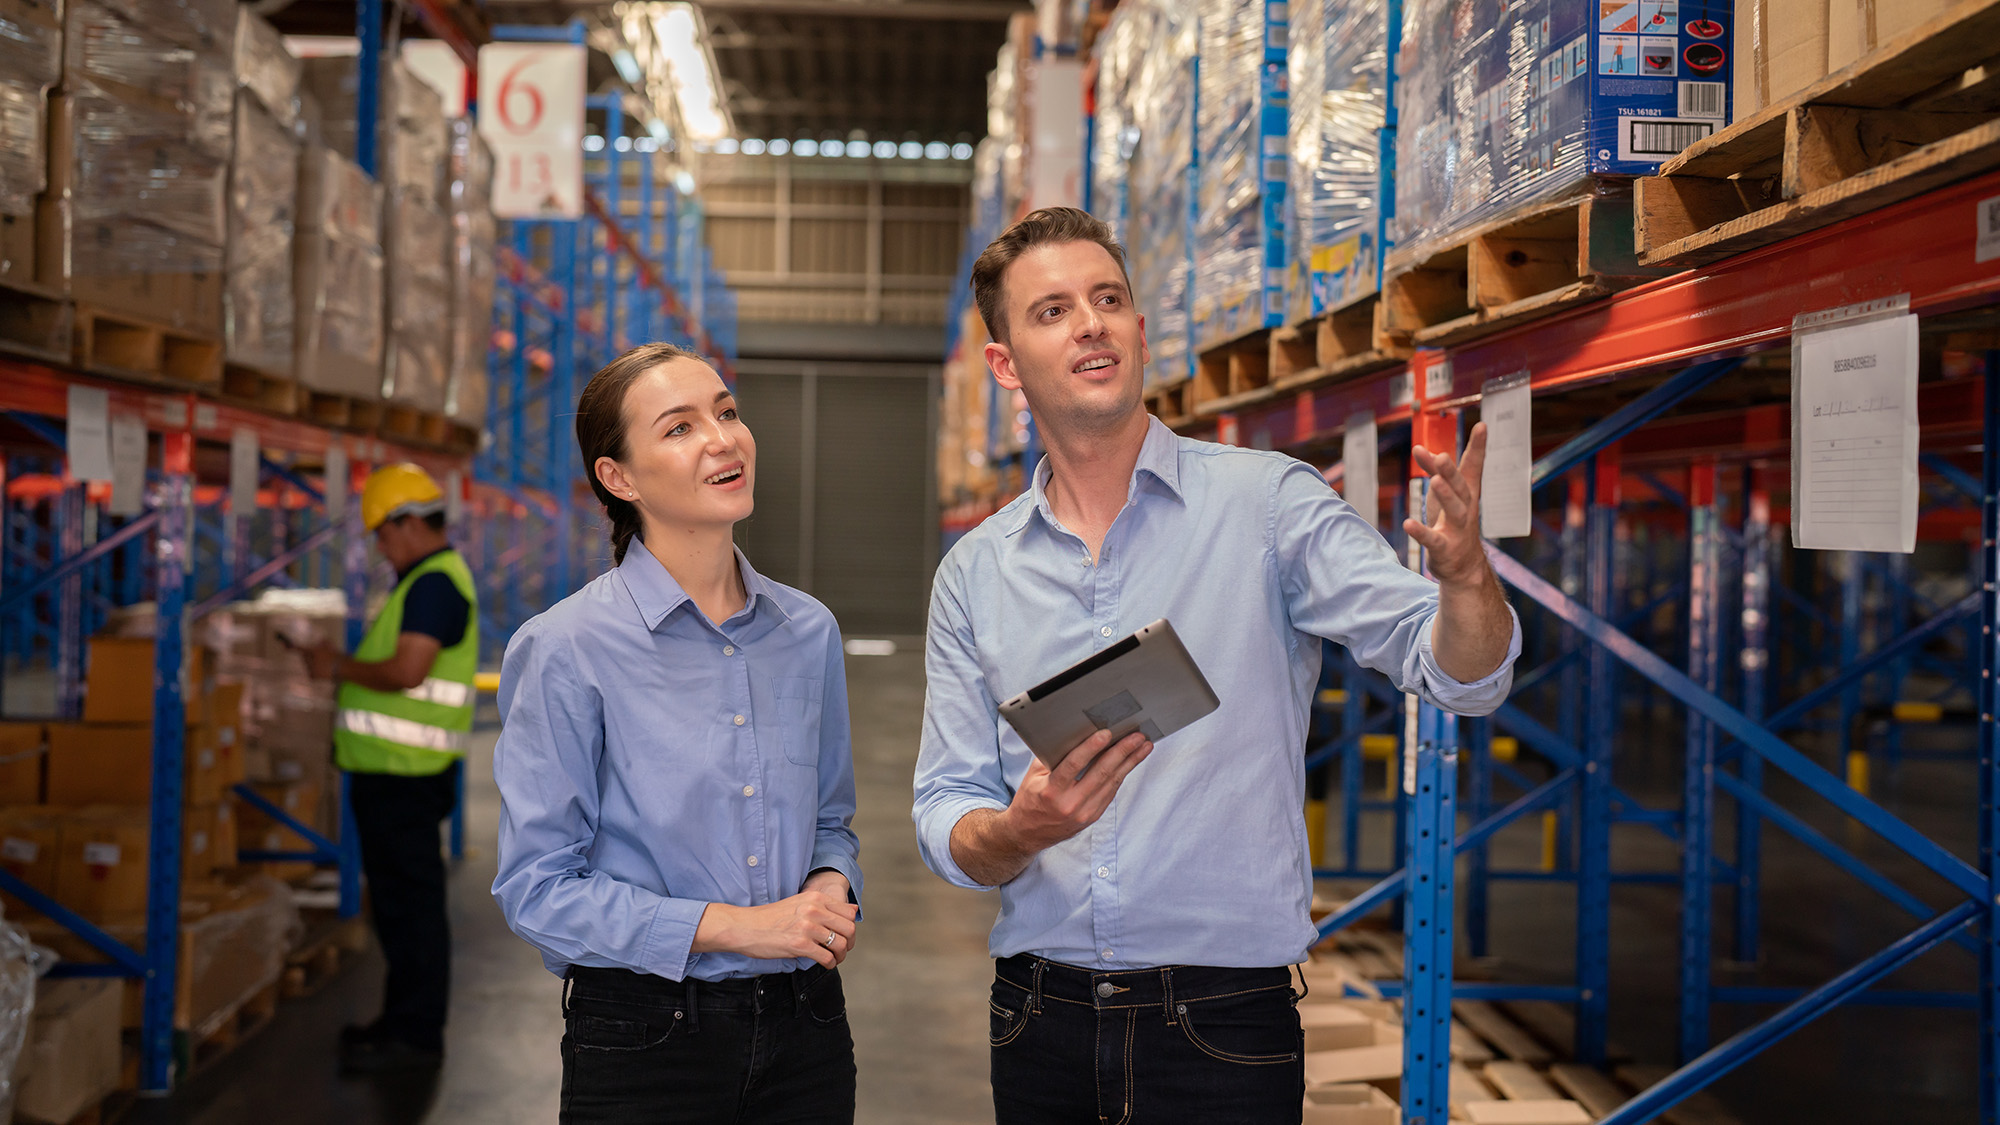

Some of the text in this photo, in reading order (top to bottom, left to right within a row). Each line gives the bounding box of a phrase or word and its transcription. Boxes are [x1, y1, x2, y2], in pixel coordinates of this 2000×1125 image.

[496, 51, 545, 137] 6
[1618, 108, 1662, 116] TSU: 161821
[508, 152, 552, 195] 13
